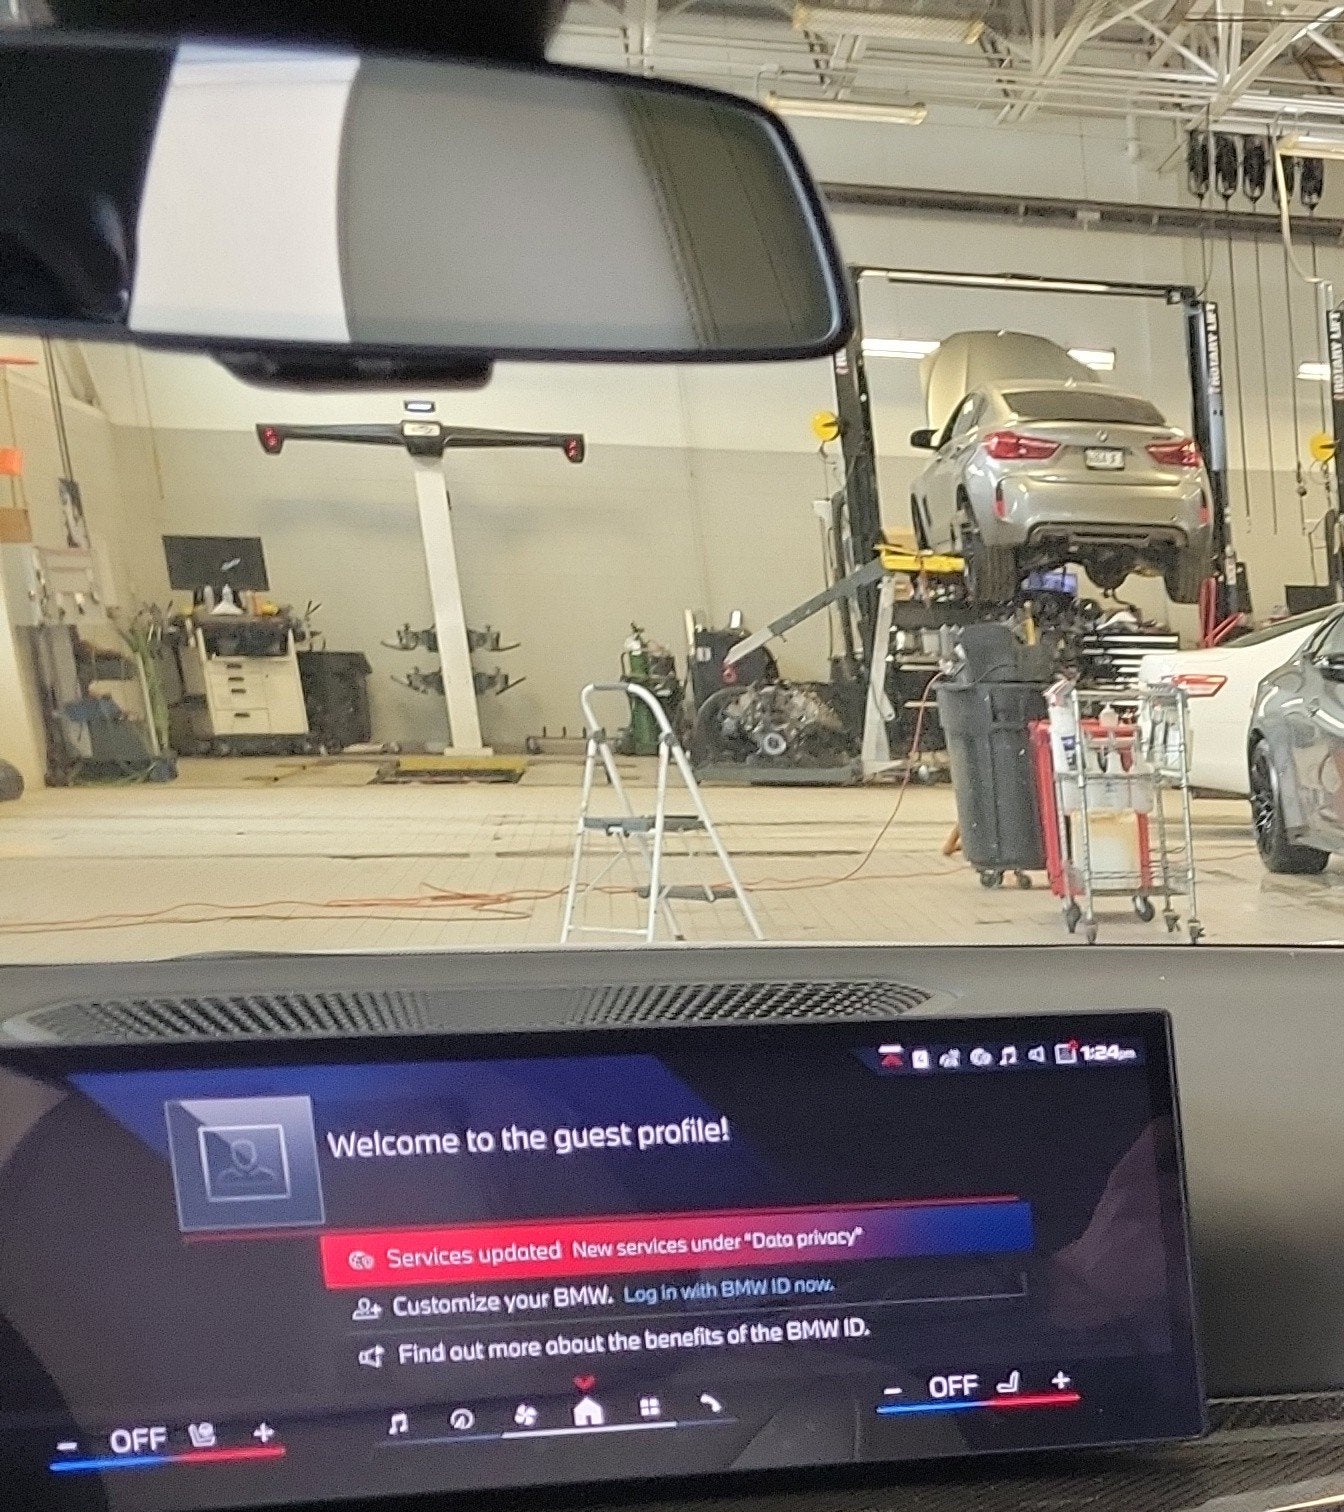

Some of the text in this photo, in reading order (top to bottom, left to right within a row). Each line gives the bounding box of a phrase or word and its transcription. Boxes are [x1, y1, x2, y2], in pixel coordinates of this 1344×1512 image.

[327, 1116, 731, 1158] Welcome to the guest profile!
[386, 1247, 473, 1269] Services
[479, 1240, 562, 1266] updated
[572, 1241, 613, 1258] New
[616, 1238, 687, 1256] services
[691, 1235, 742, 1251] under
[392, 1277, 835, 1317] Customize your BMW. Log in with BMW ID now.
[398, 1316, 870, 1365] Find out more about the benefits of the BMW ID.
[929, 1374, 979, 1398] OFF
[110, 1426, 167, 1453] OFF
